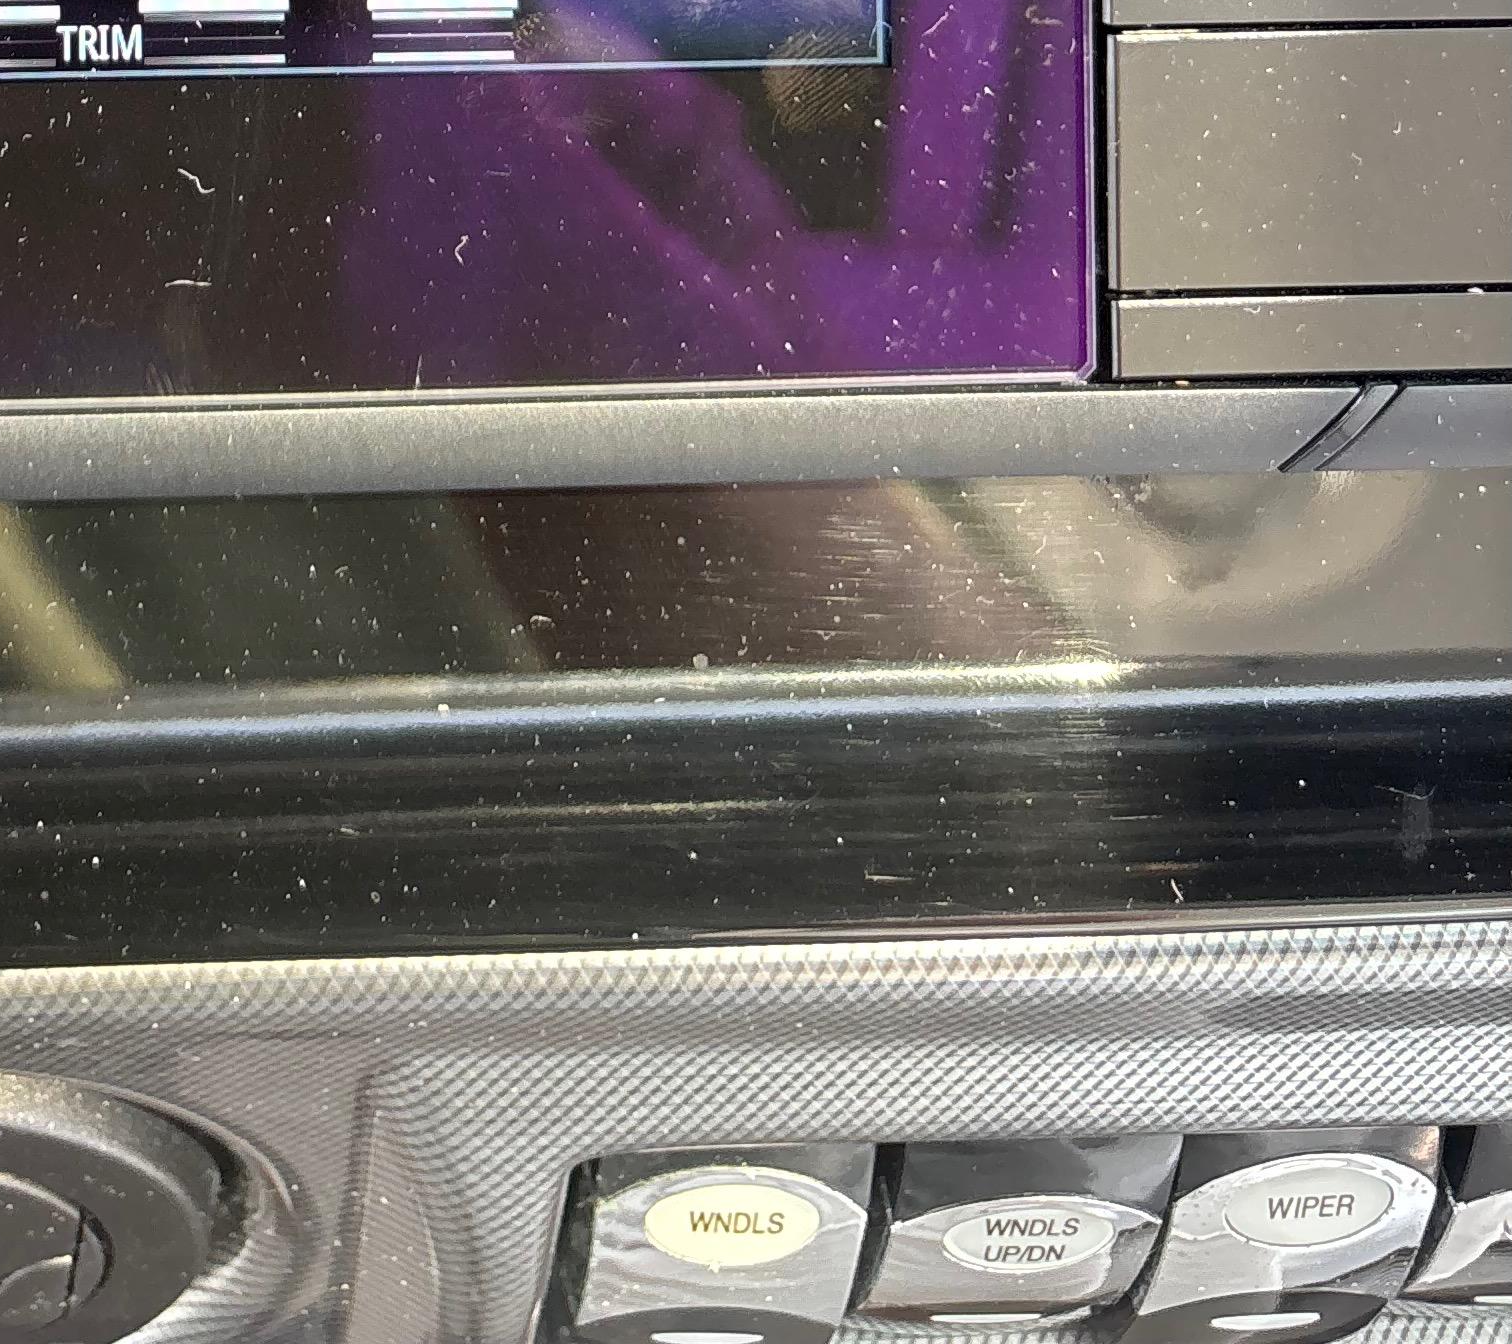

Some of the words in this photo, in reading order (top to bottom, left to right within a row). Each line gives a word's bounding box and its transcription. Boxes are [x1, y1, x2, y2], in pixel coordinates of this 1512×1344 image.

[56, 24, 144, 62] TRIM
[1266, 1193, 1356, 1222] WIPER
[688, 1210, 785, 1236] WNDLS
[984, 1217, 1081, 1240] WNDLS
[983, 1243, 1066, 1265] UP/DN
